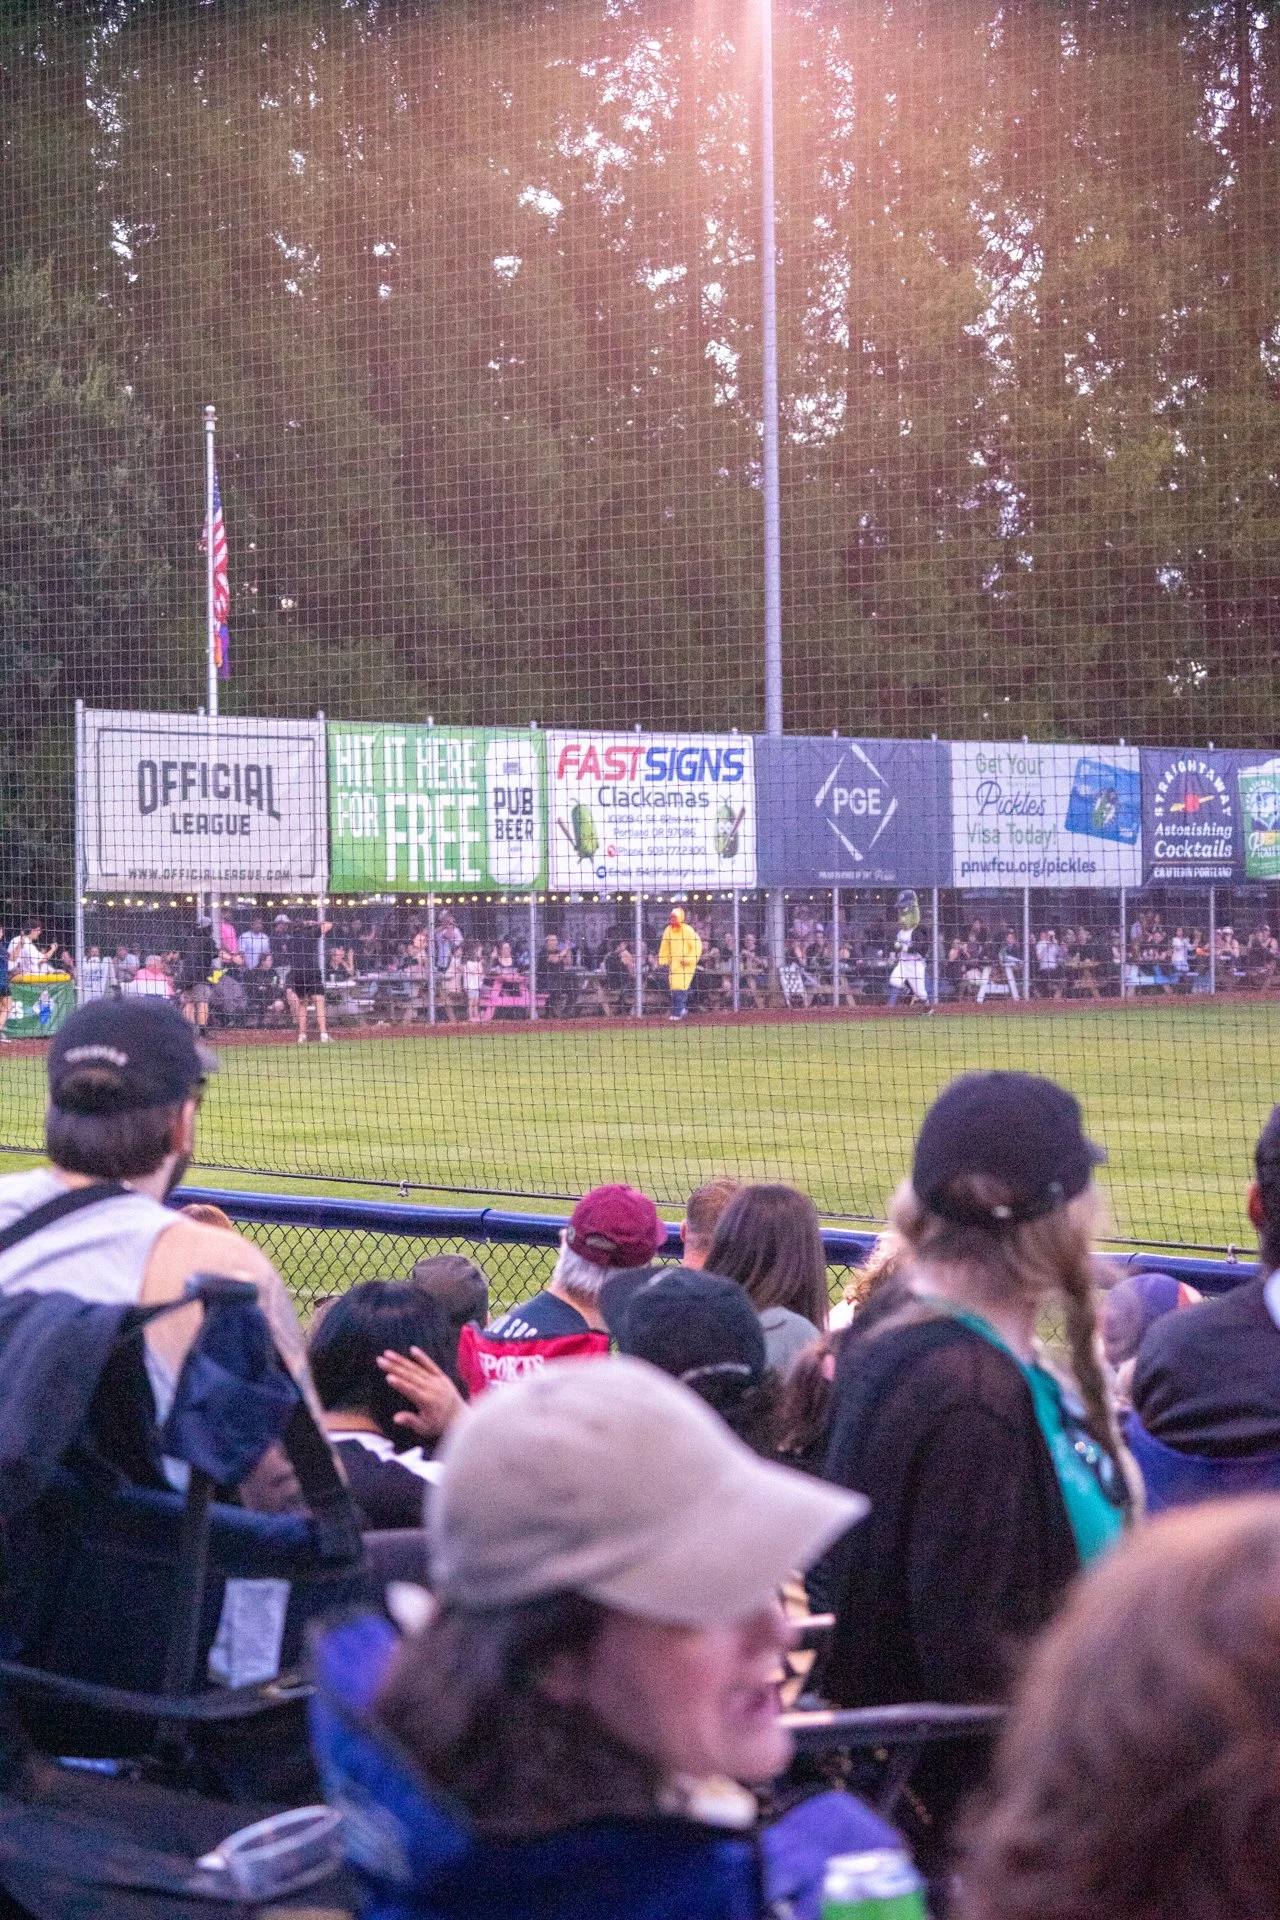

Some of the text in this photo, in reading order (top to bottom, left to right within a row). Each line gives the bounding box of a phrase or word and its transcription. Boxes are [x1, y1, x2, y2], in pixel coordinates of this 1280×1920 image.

[335, 734, 478, 789] HIT IT HERE
[557, 744, 745, 782] FASTSIGNS
[975, 752, 1045, 775] Get Your
[138, 759, 281, 822] OFFICIAL
[493, 787, 533, 815] PUB
[598, 786, 710, 808] Clackamas
[833, 787, 882, 816] PGE
[976, 780, 1047, 816] Pickles
[171, 812, 251, 835] LEAGUE
[337, 791, 481, 882] FOR FREE
[494, 818, 534, 840] BEER
[967, 822, 1058, 849] Visa Today!
[1155, 822, 1233, 839] Astonishing
[1154, 839, 1233, 858] Cocktails
[961, 857, 1097, 878] pnwfcu.org/pickles
